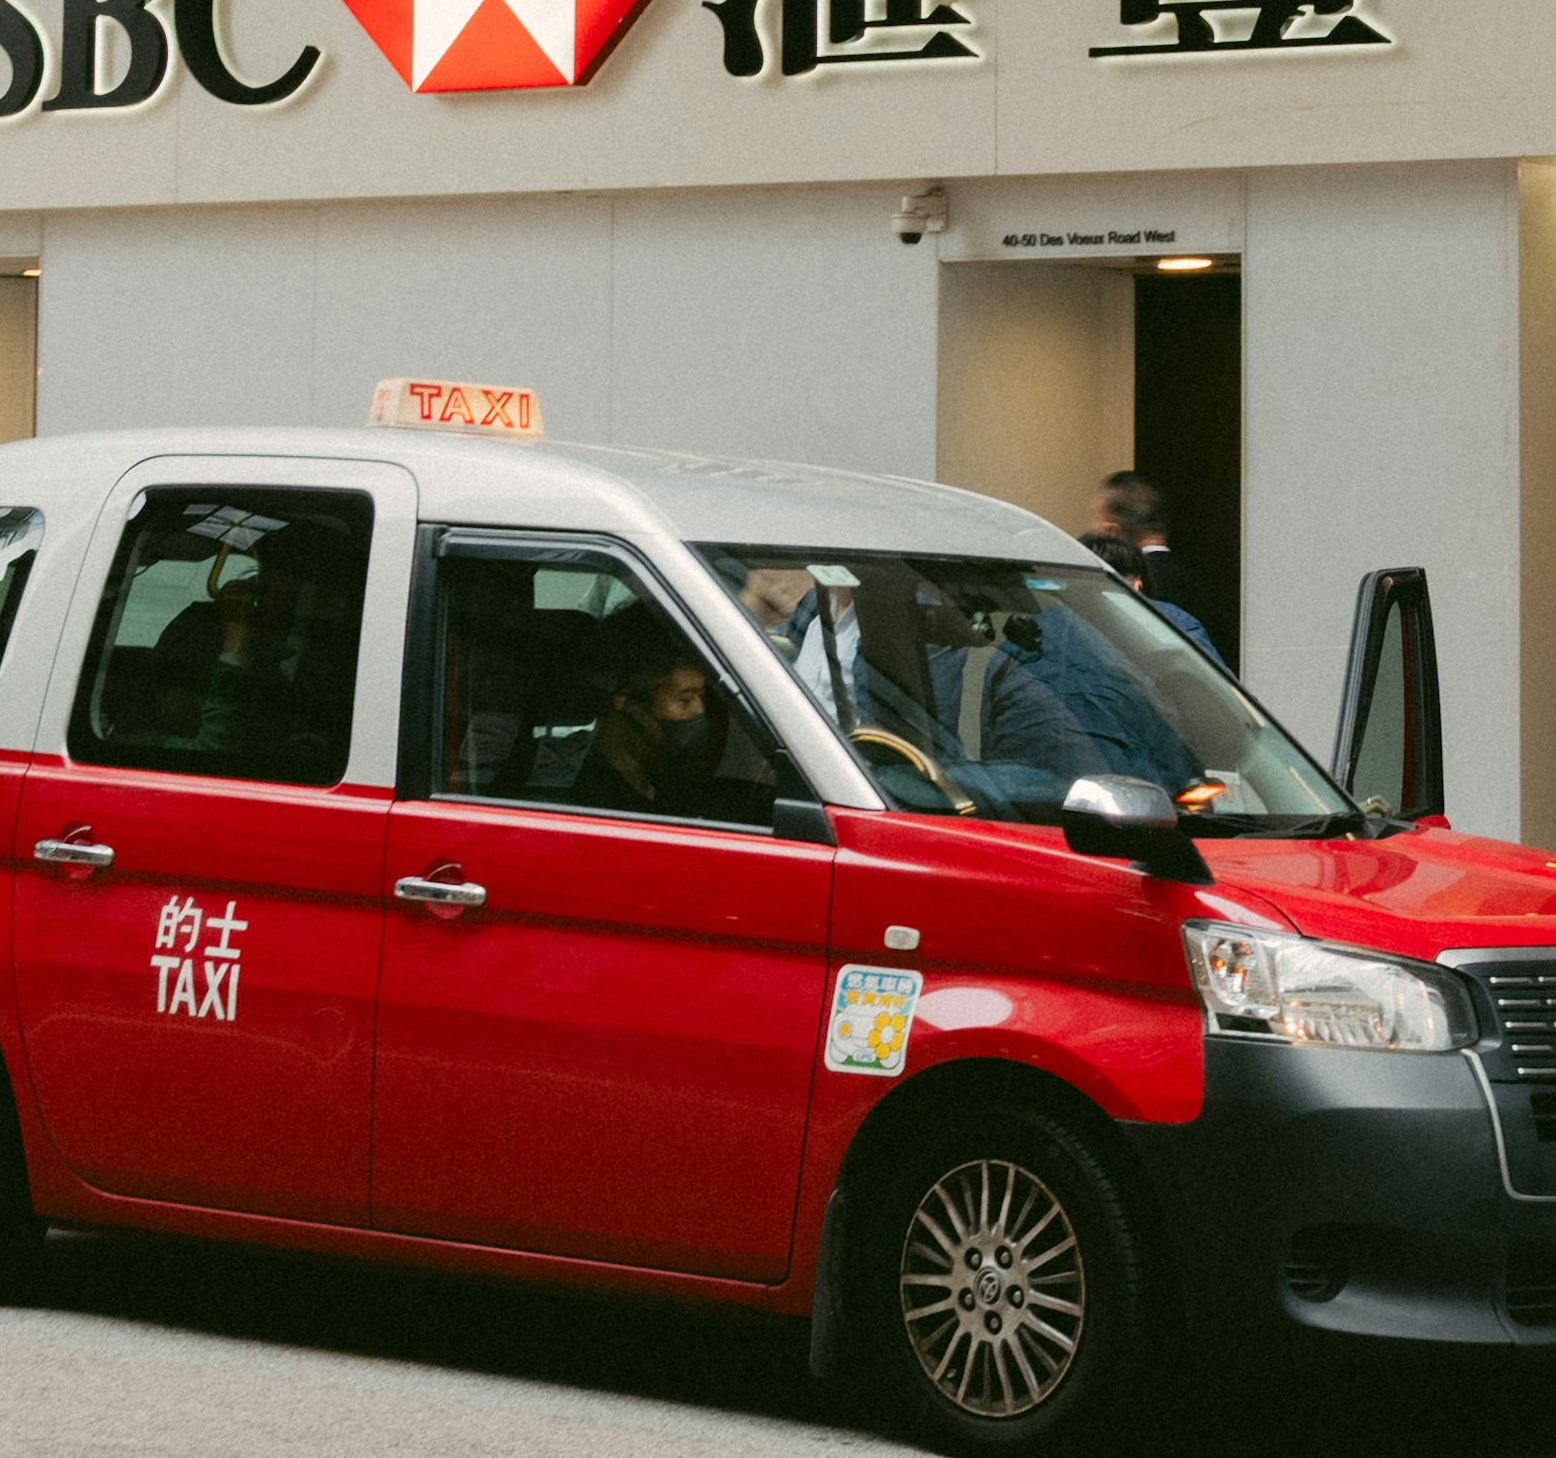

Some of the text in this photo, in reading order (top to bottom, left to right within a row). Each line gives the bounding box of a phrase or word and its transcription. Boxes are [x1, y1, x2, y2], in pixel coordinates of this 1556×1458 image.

[1002, 230, 1176, 247] 40-50 Des Voeux Road West
[409, 383, 530, 429] TAXI
[154, 895, 249, 959] 的士
[150, 954, 241, 1021] TAXI
